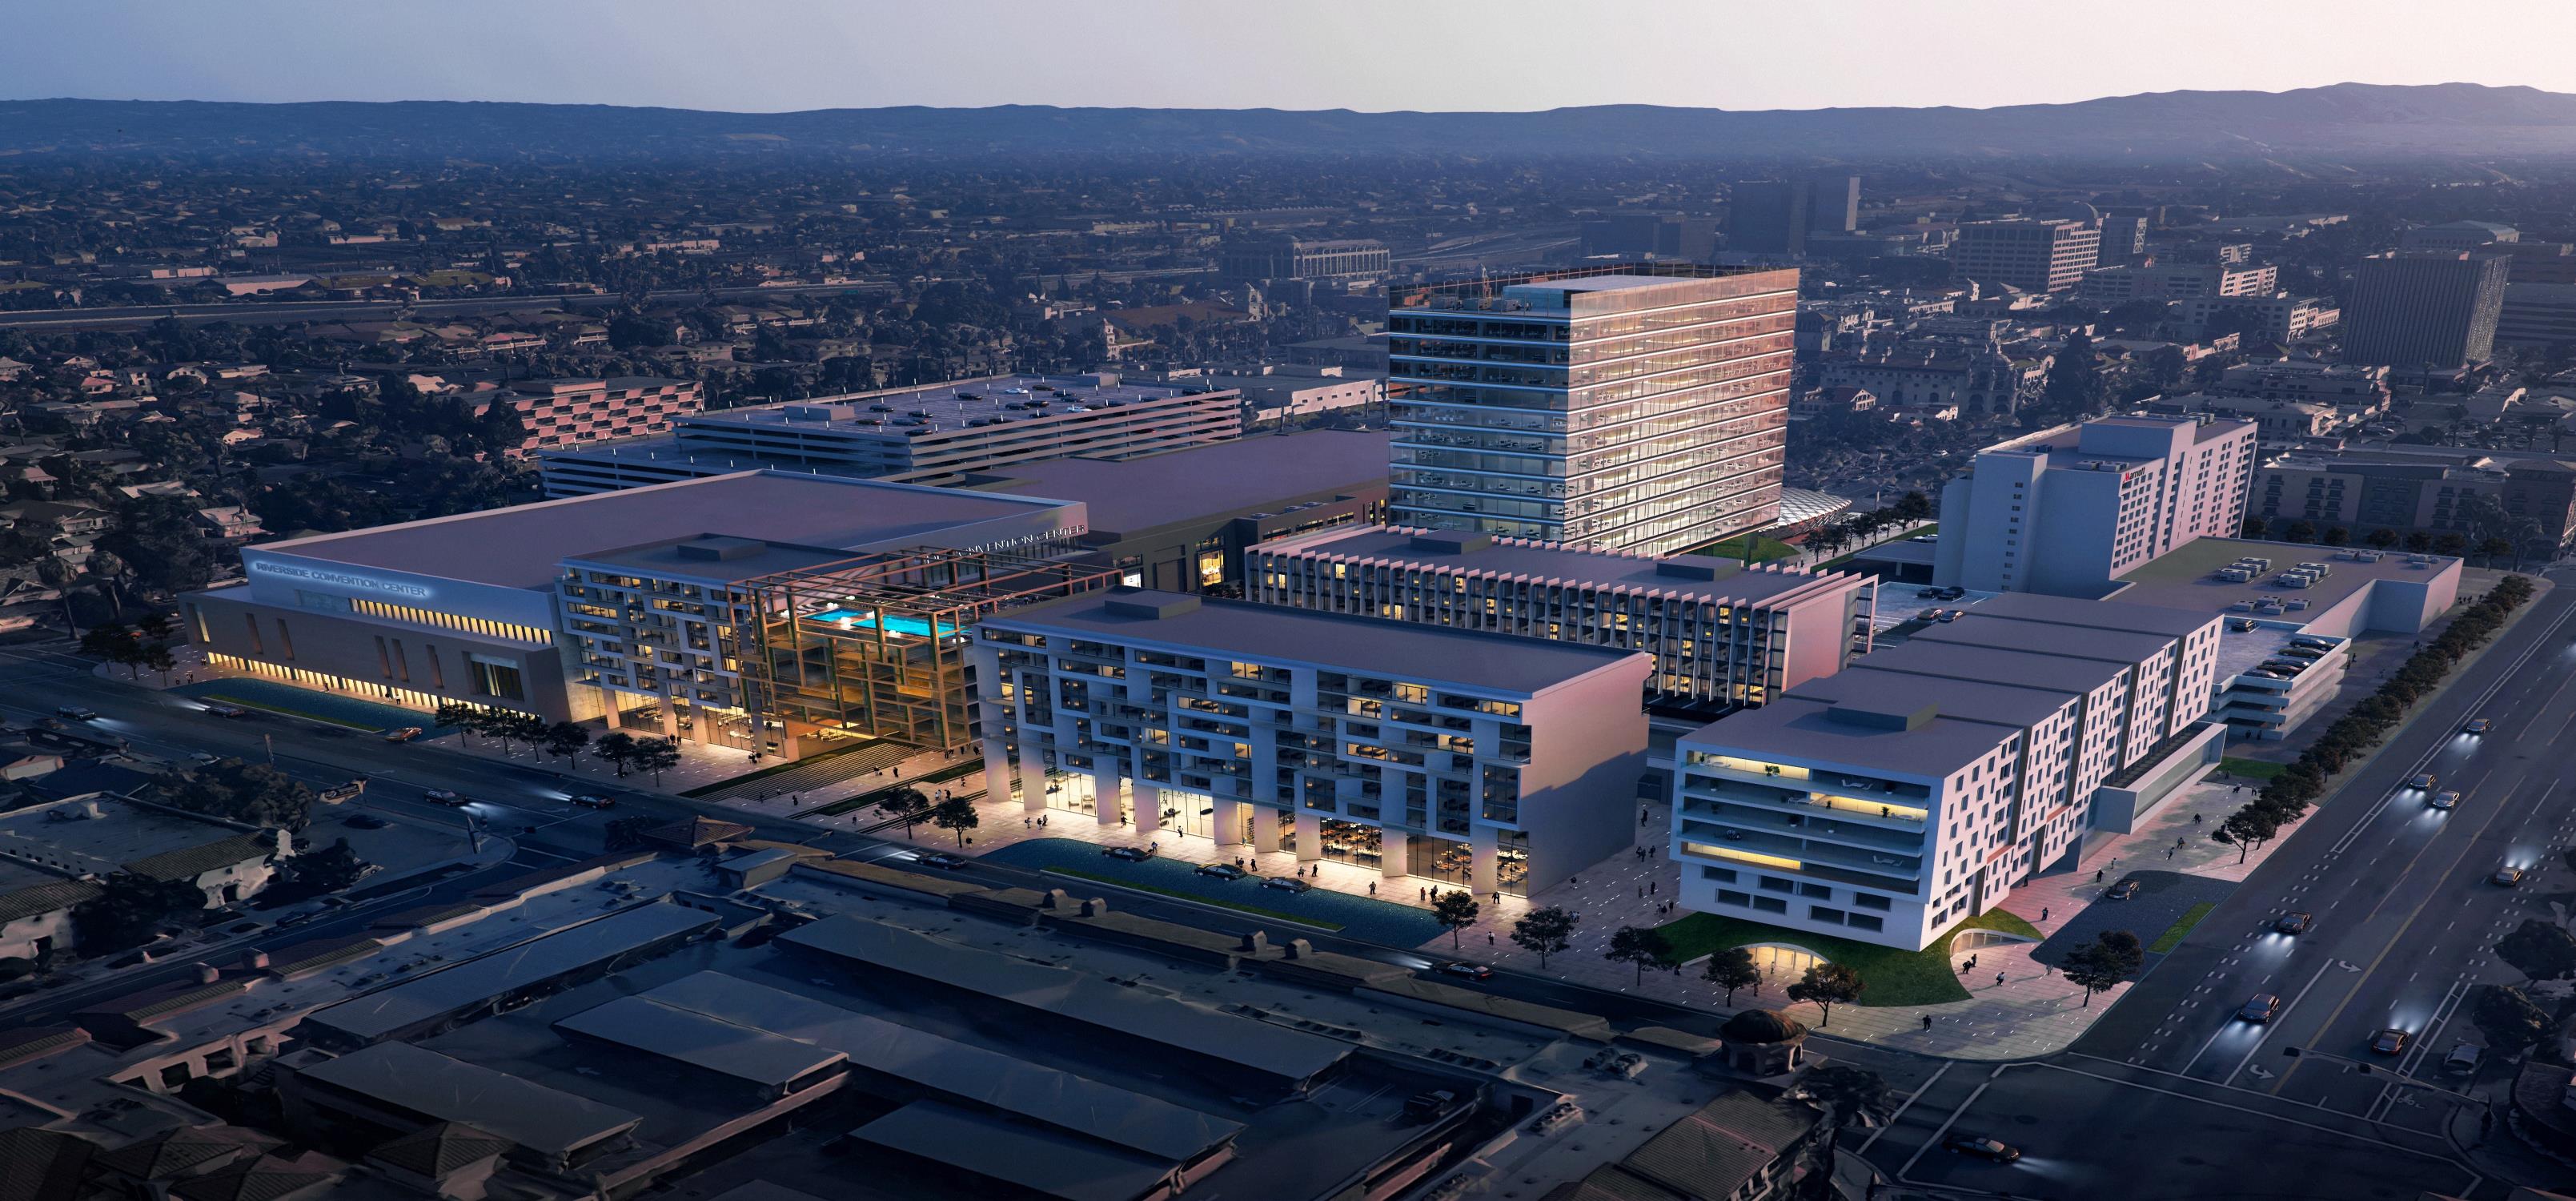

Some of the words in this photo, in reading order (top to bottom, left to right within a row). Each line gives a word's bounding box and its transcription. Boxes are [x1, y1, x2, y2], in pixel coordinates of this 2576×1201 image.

[951, 535, 1033, 557] ONVENTION
[1037, 524, 1085, 541] CENTER
[256, 563, 310, 577] RIVERSIDE
[312, 572, 379, 588] CONVENTION
[383, 582, 427, 596] CENTER
